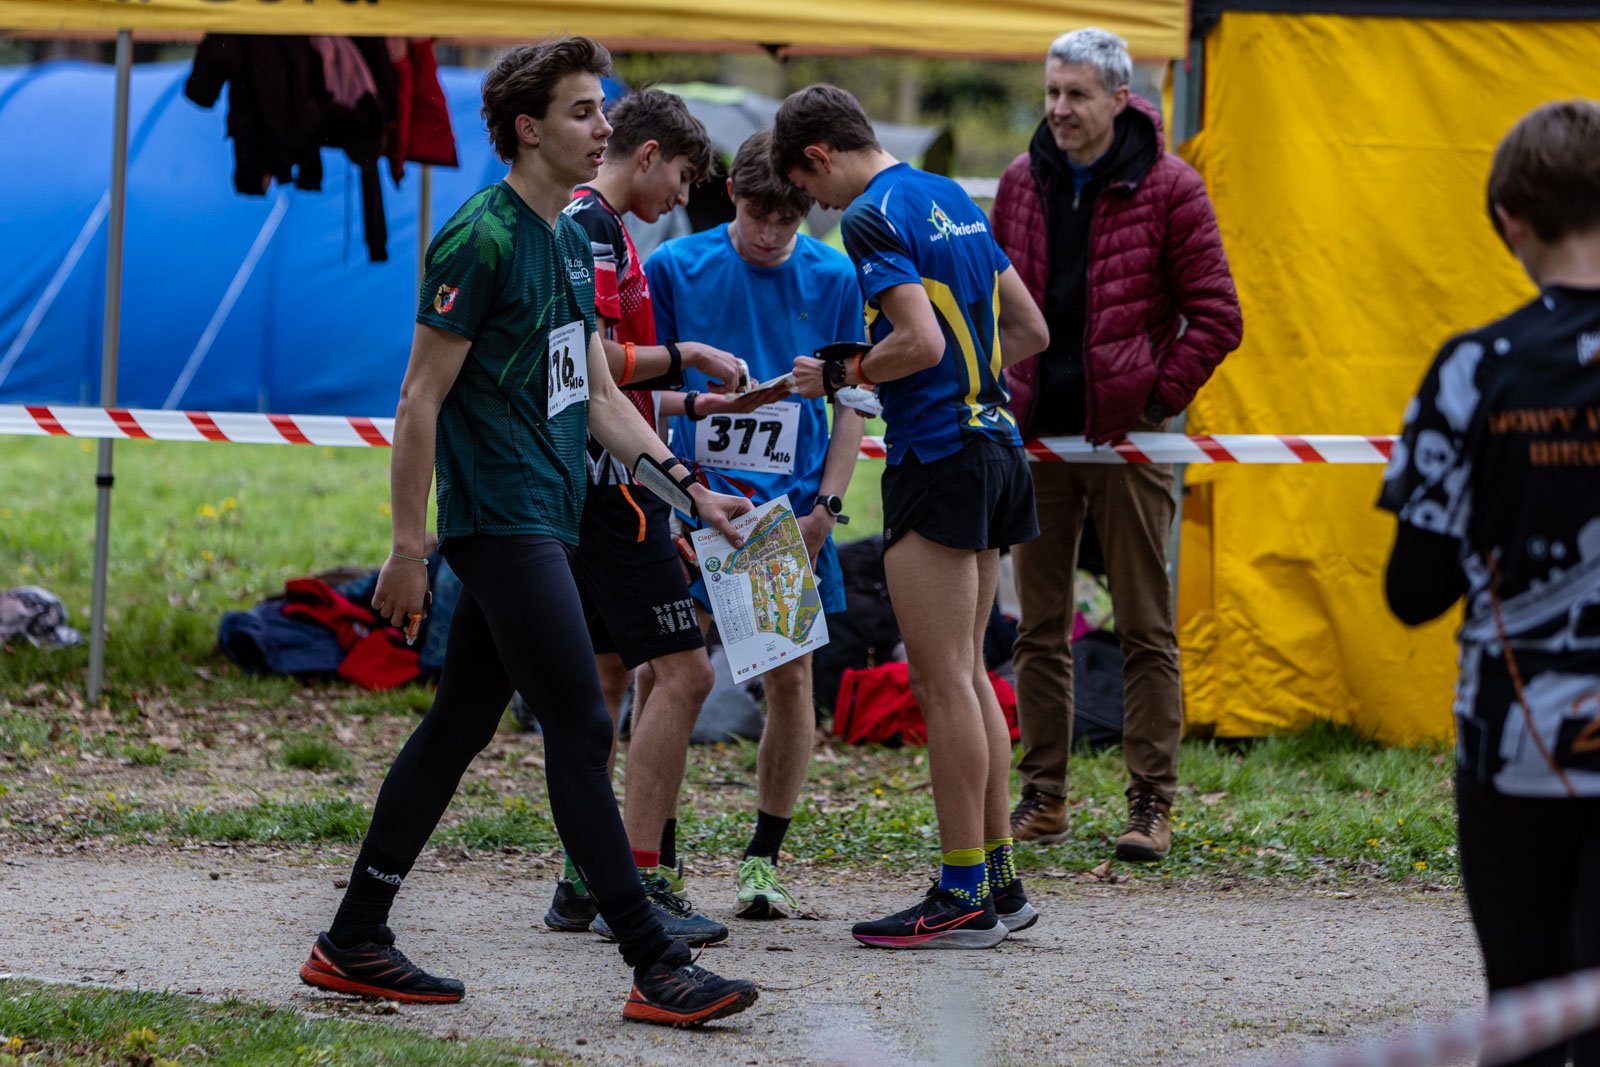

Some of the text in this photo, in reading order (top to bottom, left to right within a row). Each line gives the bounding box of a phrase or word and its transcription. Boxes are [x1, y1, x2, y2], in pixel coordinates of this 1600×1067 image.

[569, 376, 585, 391] M16
[707, 416, 783, 457] 377
[770, 451, 791, 463] M16
